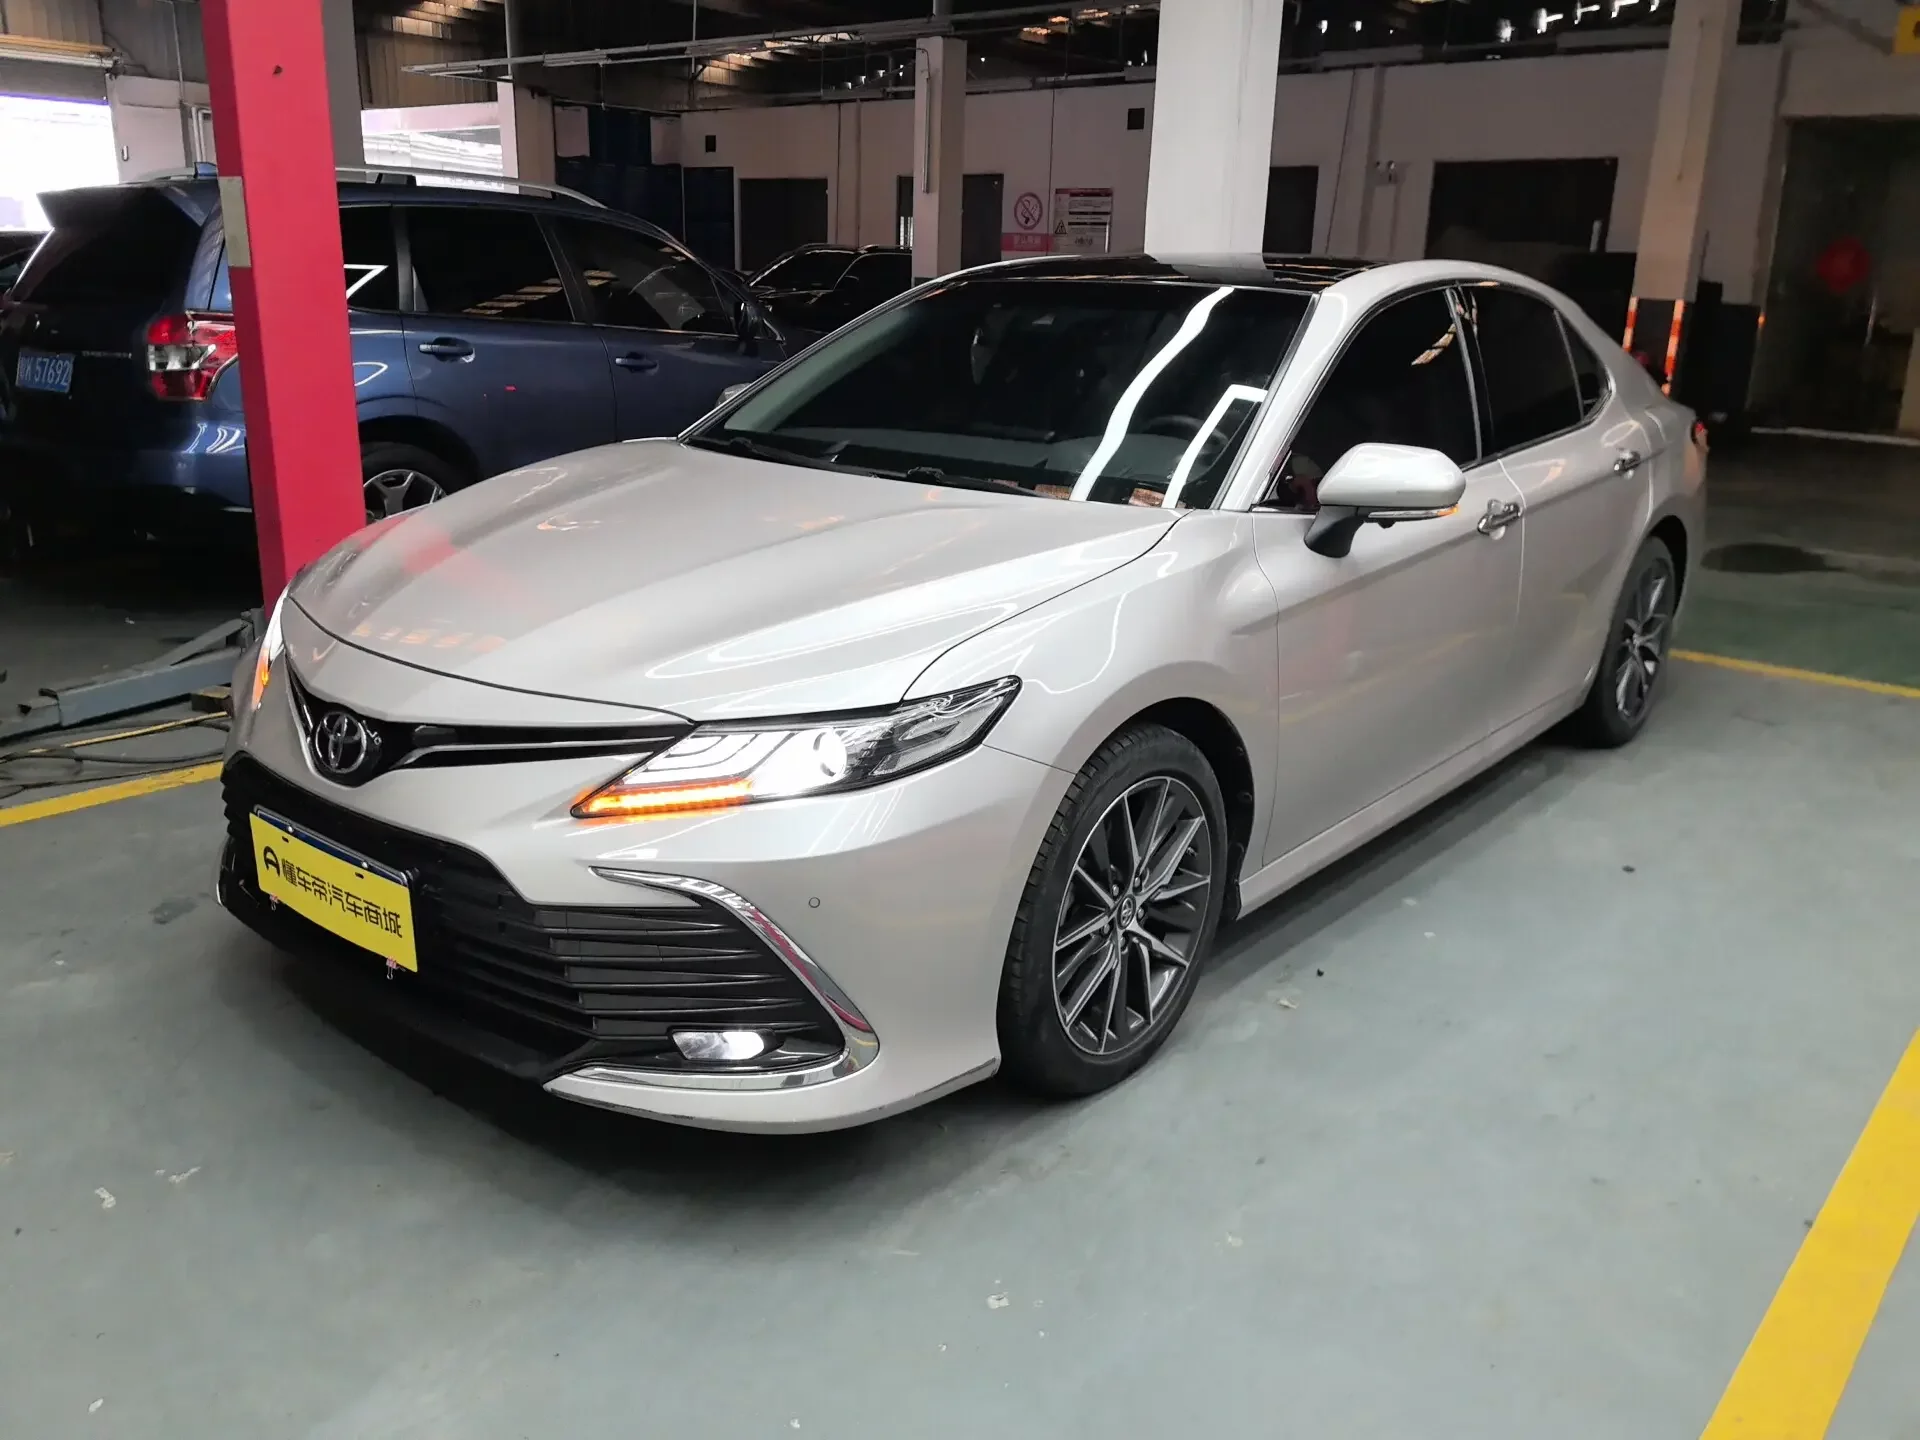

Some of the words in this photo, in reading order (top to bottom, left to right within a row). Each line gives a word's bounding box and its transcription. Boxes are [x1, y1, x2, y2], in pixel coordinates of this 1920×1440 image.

[281, 858, 403, 938] 懂车帝汽车商城
